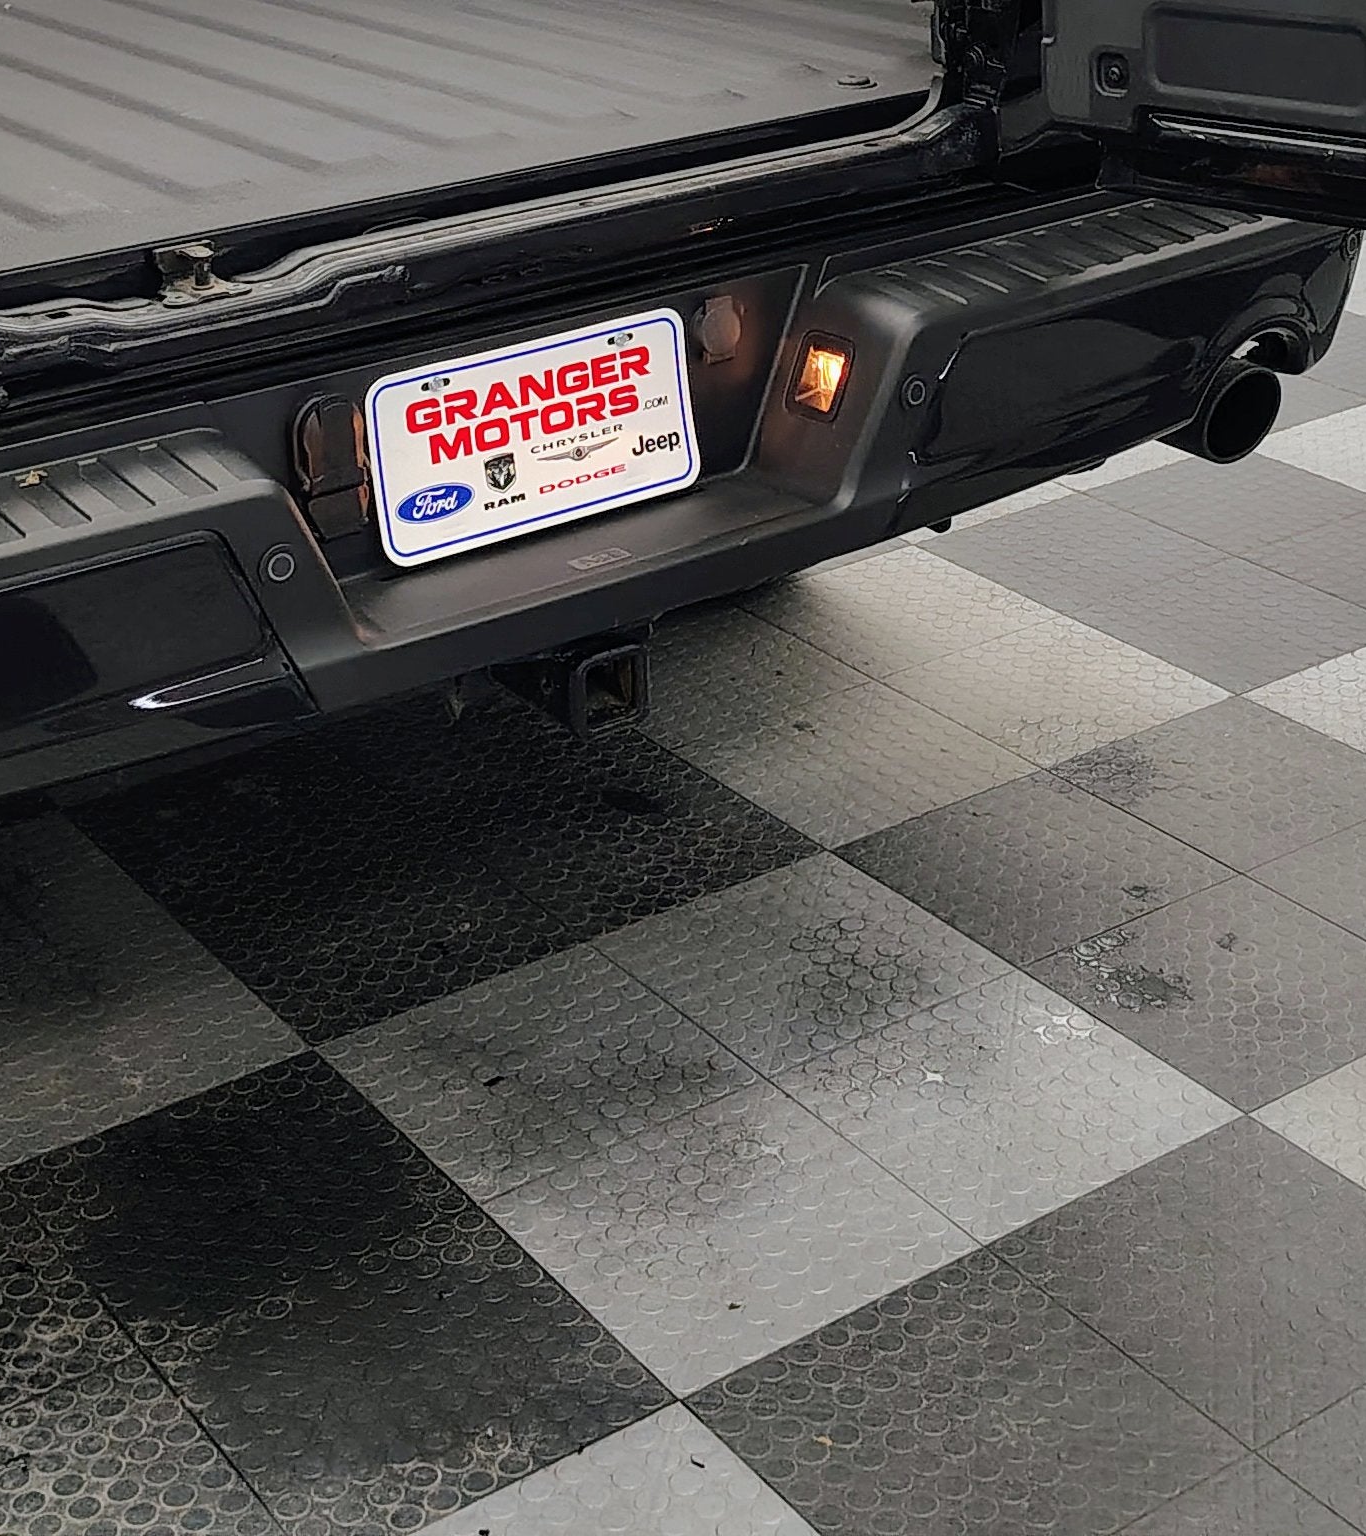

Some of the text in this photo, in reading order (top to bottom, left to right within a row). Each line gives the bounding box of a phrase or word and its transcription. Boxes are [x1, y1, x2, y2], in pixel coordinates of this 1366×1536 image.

[405, 345, 650, 434] GRANGER
[428, 384, 669, 465] MOTORS .COM
[530, 423, 624, 454] CHRYSLER
[632, 431, 680, 457] Jeep
[539, 464, 627, 495] DODGE
[412, 488, 458, 519] Ford
[483, 492, 526, 511] RAM
